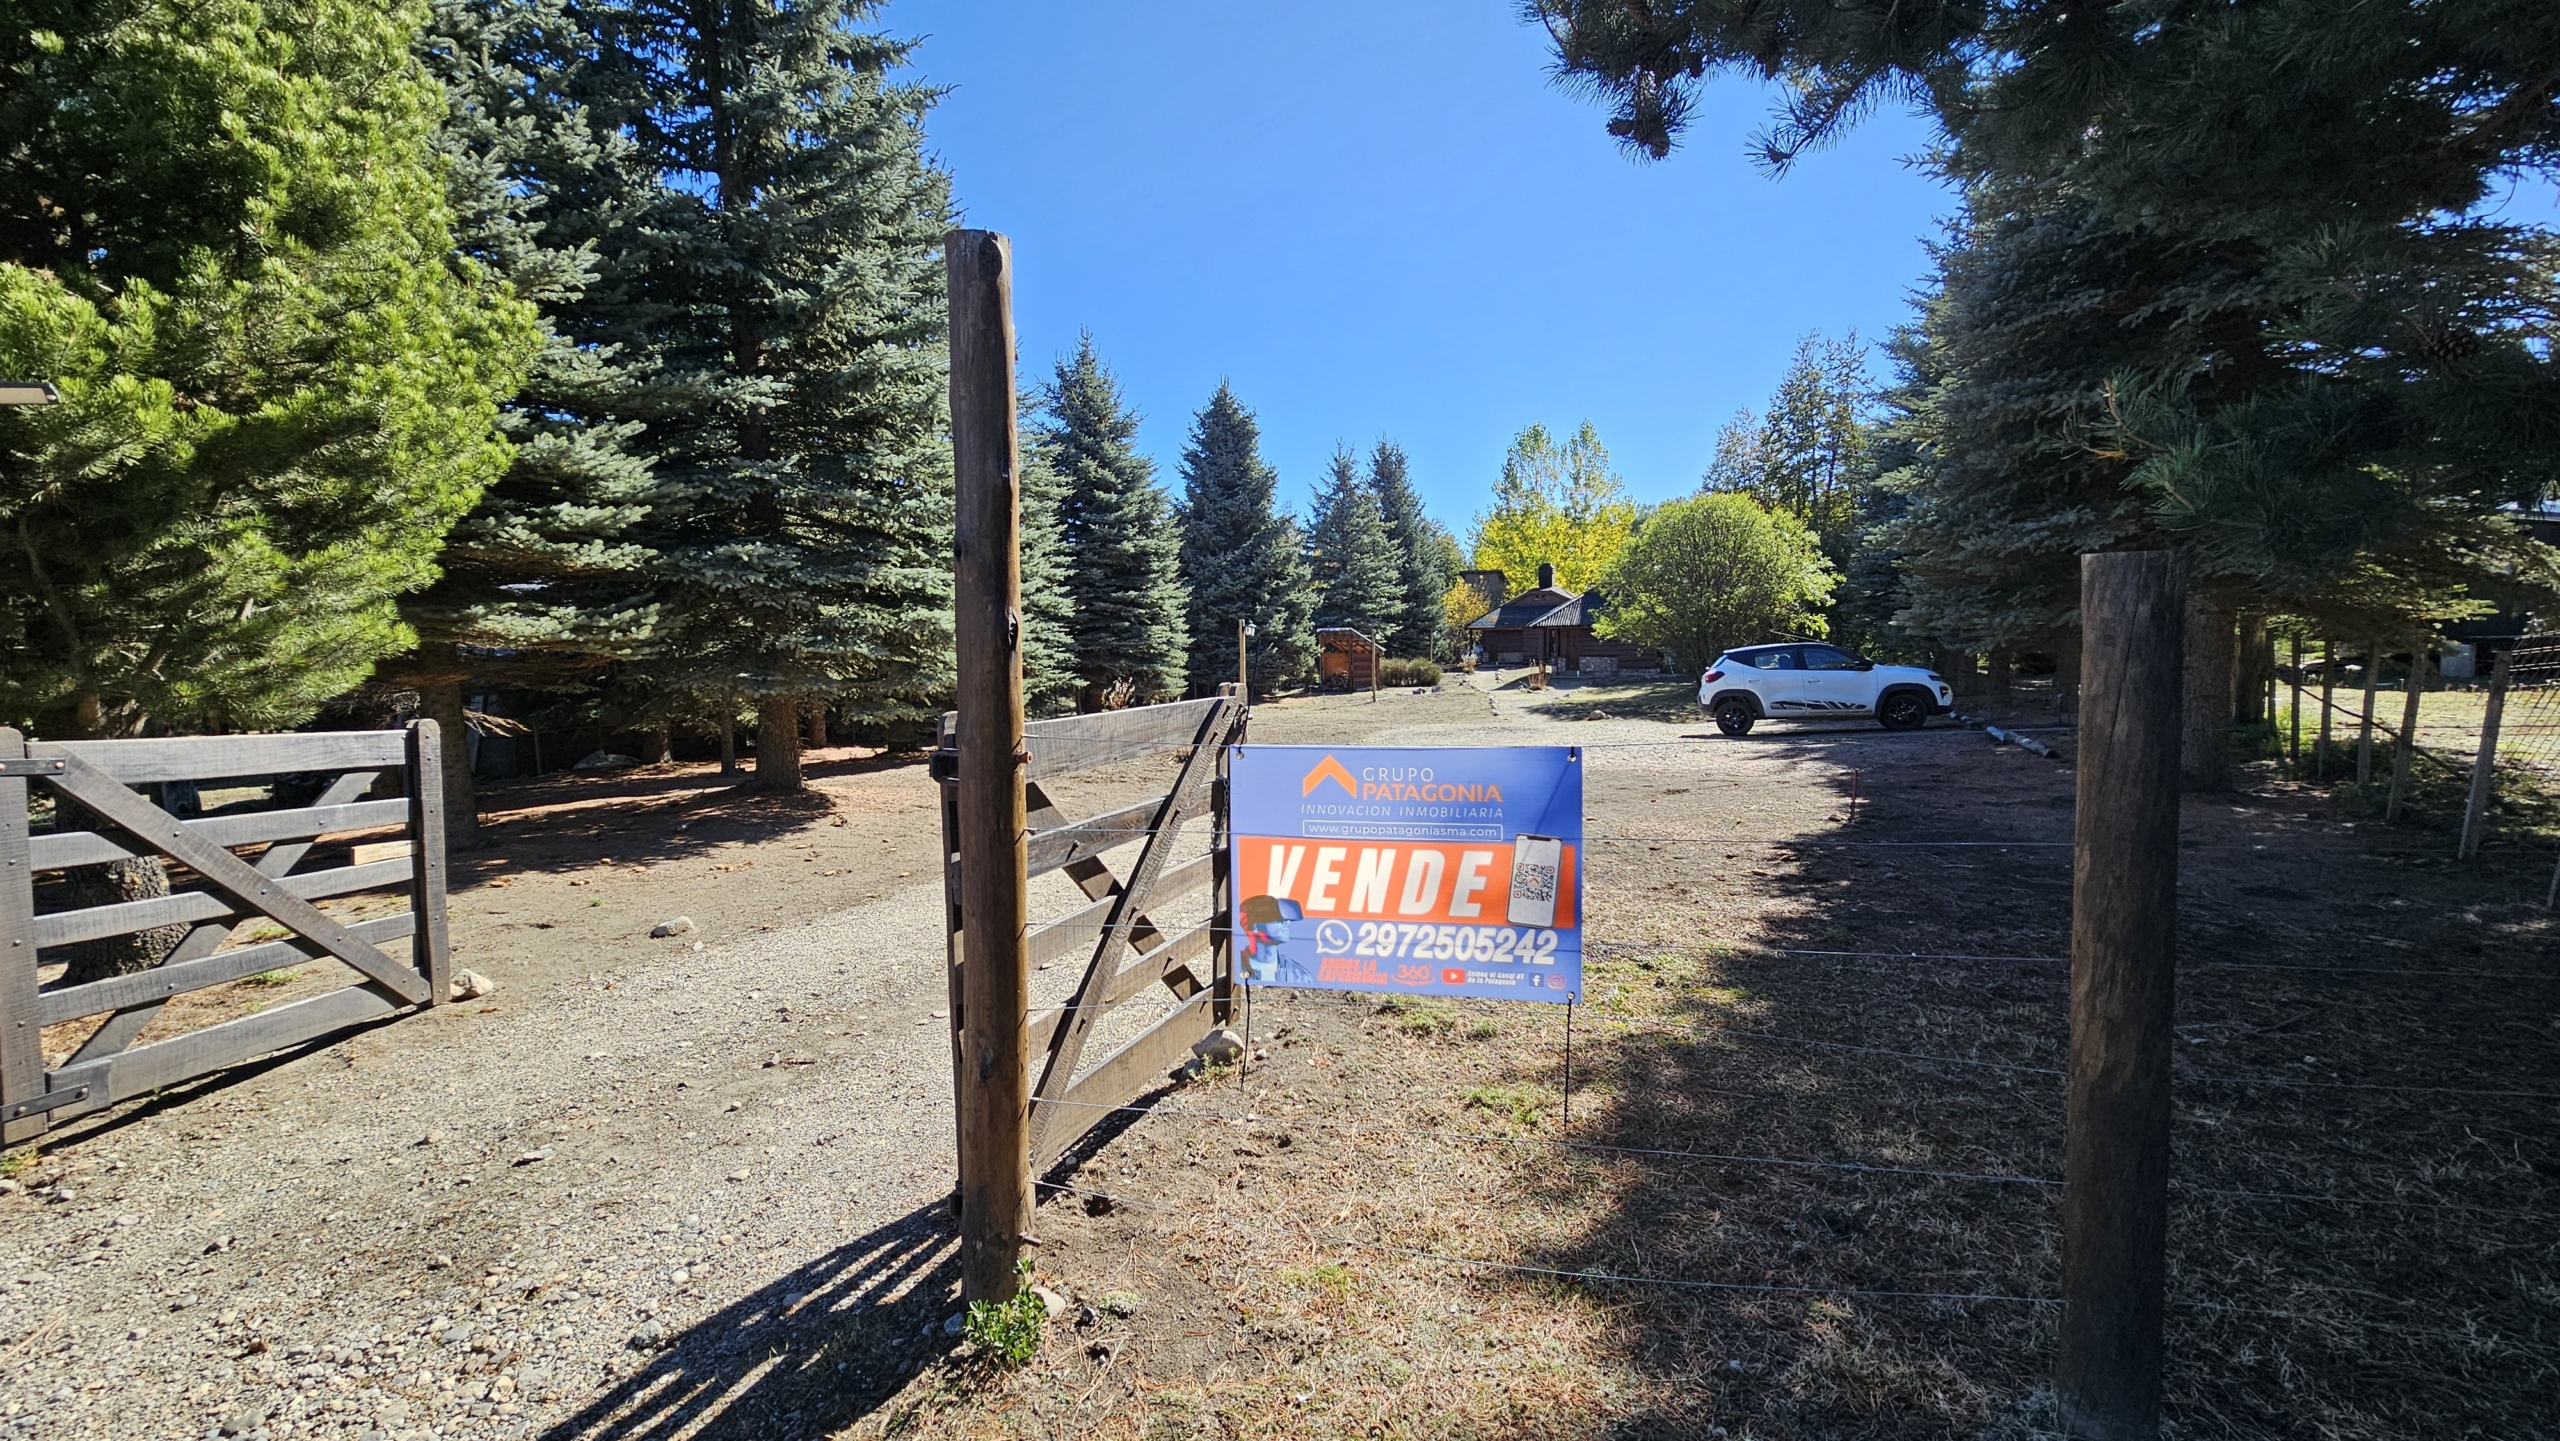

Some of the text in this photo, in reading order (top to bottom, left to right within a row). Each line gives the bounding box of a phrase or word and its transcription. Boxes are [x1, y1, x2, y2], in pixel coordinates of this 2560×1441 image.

[1363, 767, 1434, 783] GRUPO
[1363, 783, 1502, 802] PATAGONIA
[1301, 804, 1503, 819] INNOVACION INMOBILIARIA
[1308, 824, 1497, 838] www.grupopatagoniasma.com
[1267, 845, 1494, 917] VENDE
[1355, 922, 1558, 965] 2972505242
